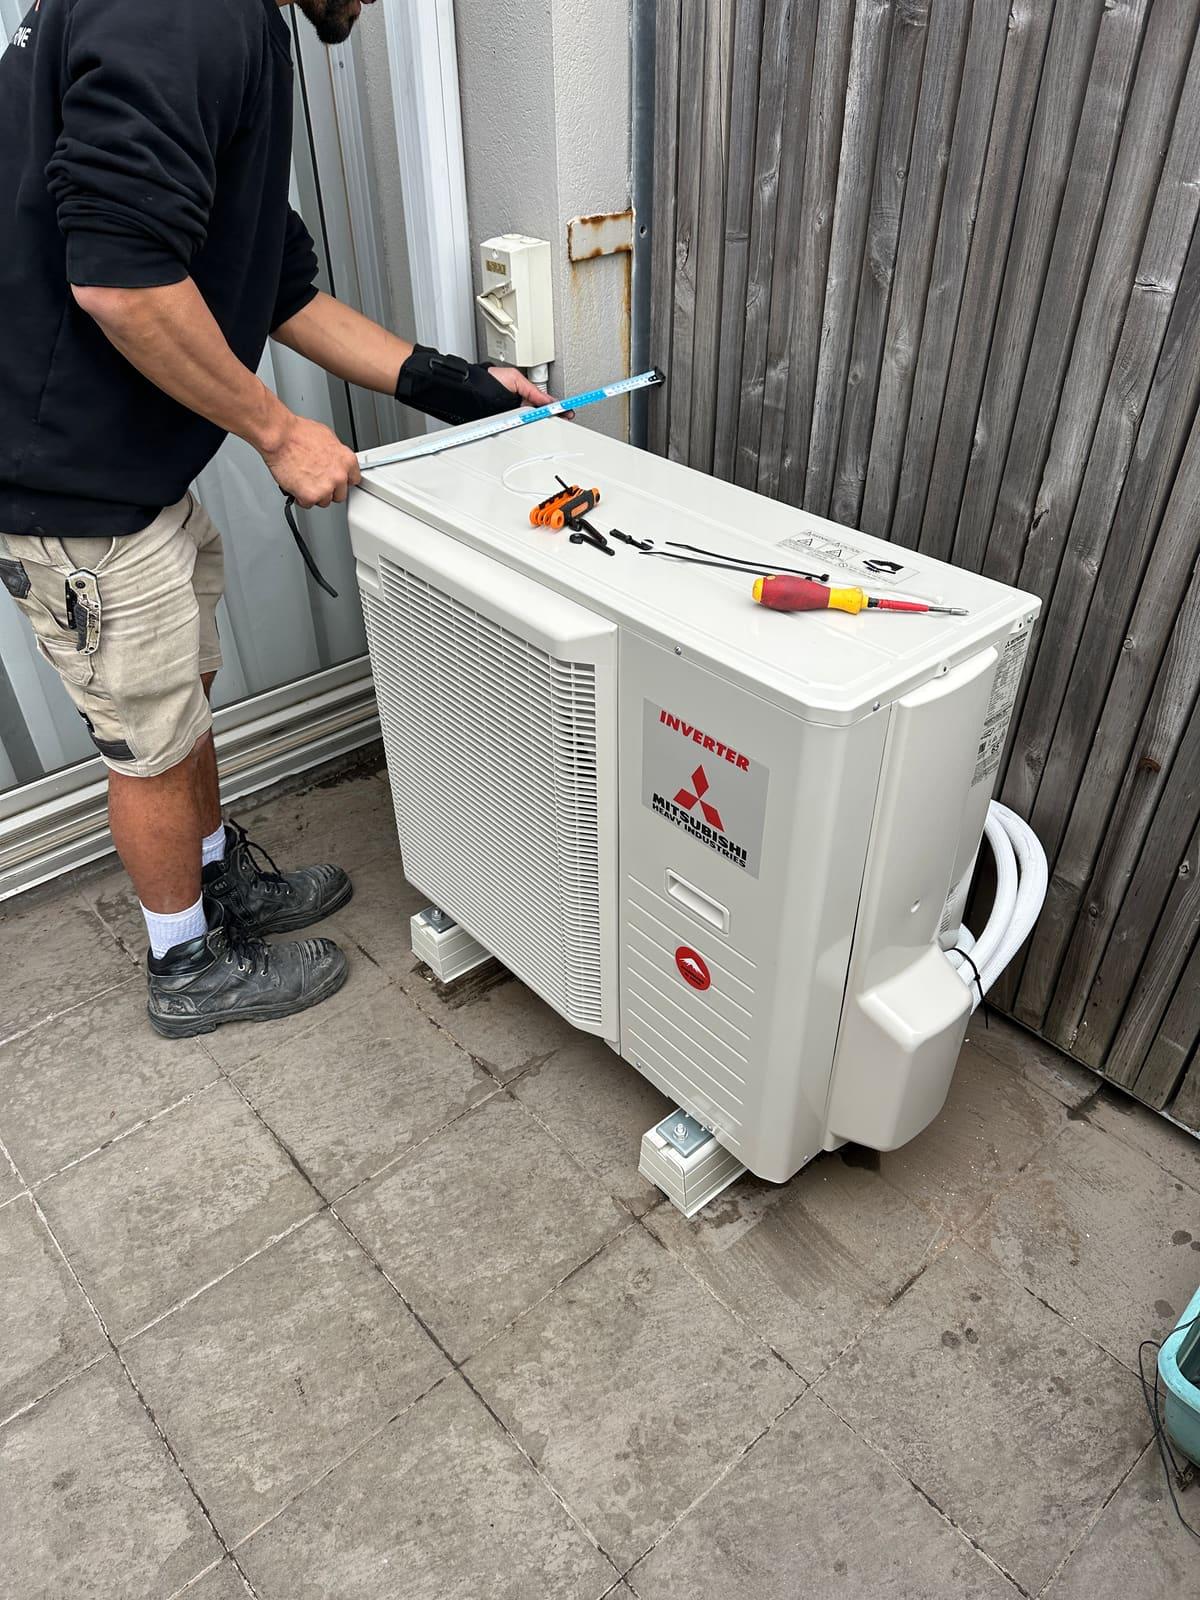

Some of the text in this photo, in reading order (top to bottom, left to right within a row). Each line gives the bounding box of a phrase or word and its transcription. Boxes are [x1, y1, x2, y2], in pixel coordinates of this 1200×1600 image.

[659, 709, 750, 772] INVERTER
[652, 792, 748, 861] MITSUBISHI
[652, 803, 746, 868] HEAVY INDUSTRIES
